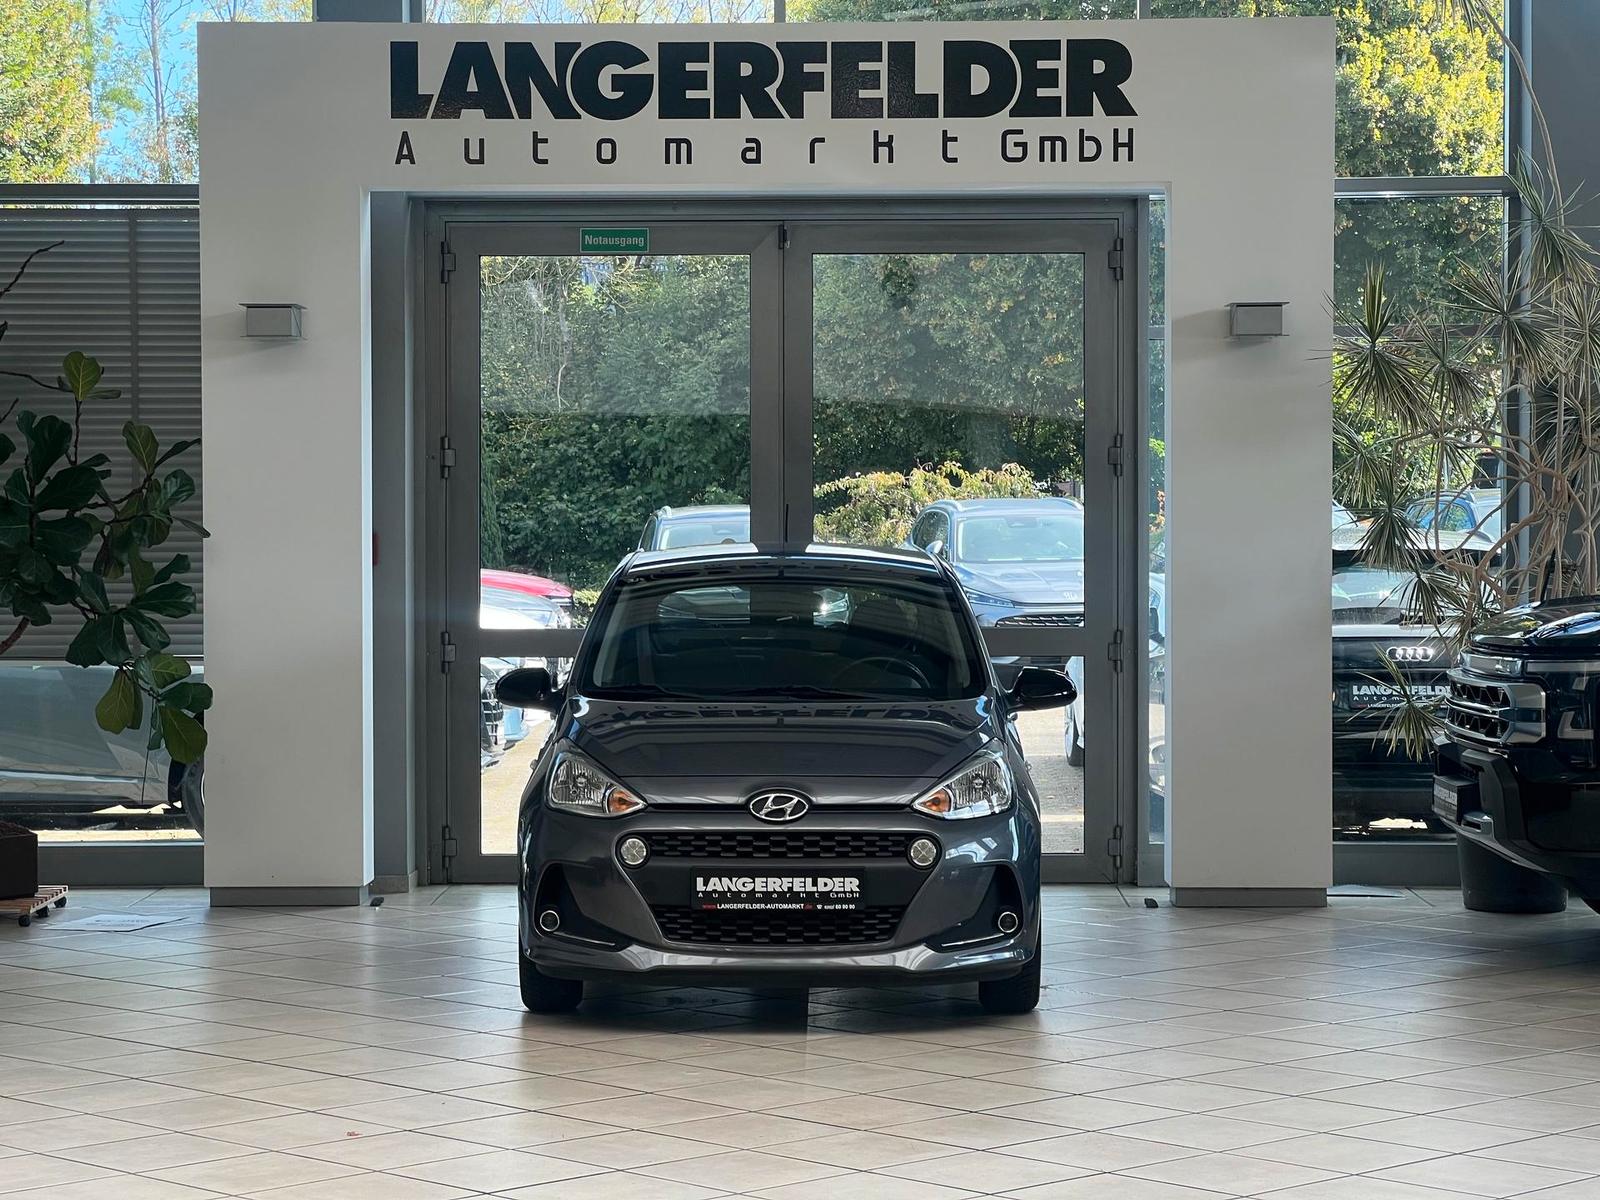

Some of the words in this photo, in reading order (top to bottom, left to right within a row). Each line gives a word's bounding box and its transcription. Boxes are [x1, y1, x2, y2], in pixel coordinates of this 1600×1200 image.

[390, 38, 1138, 120] LANGERFELDER
[395, 129, 960, 165] Automarkt
[1001, 127, 1134, 164] GmbH
[584, 234, 645, 247] Notausgang
[696, 877, 860, 892] LANGERFELDER
